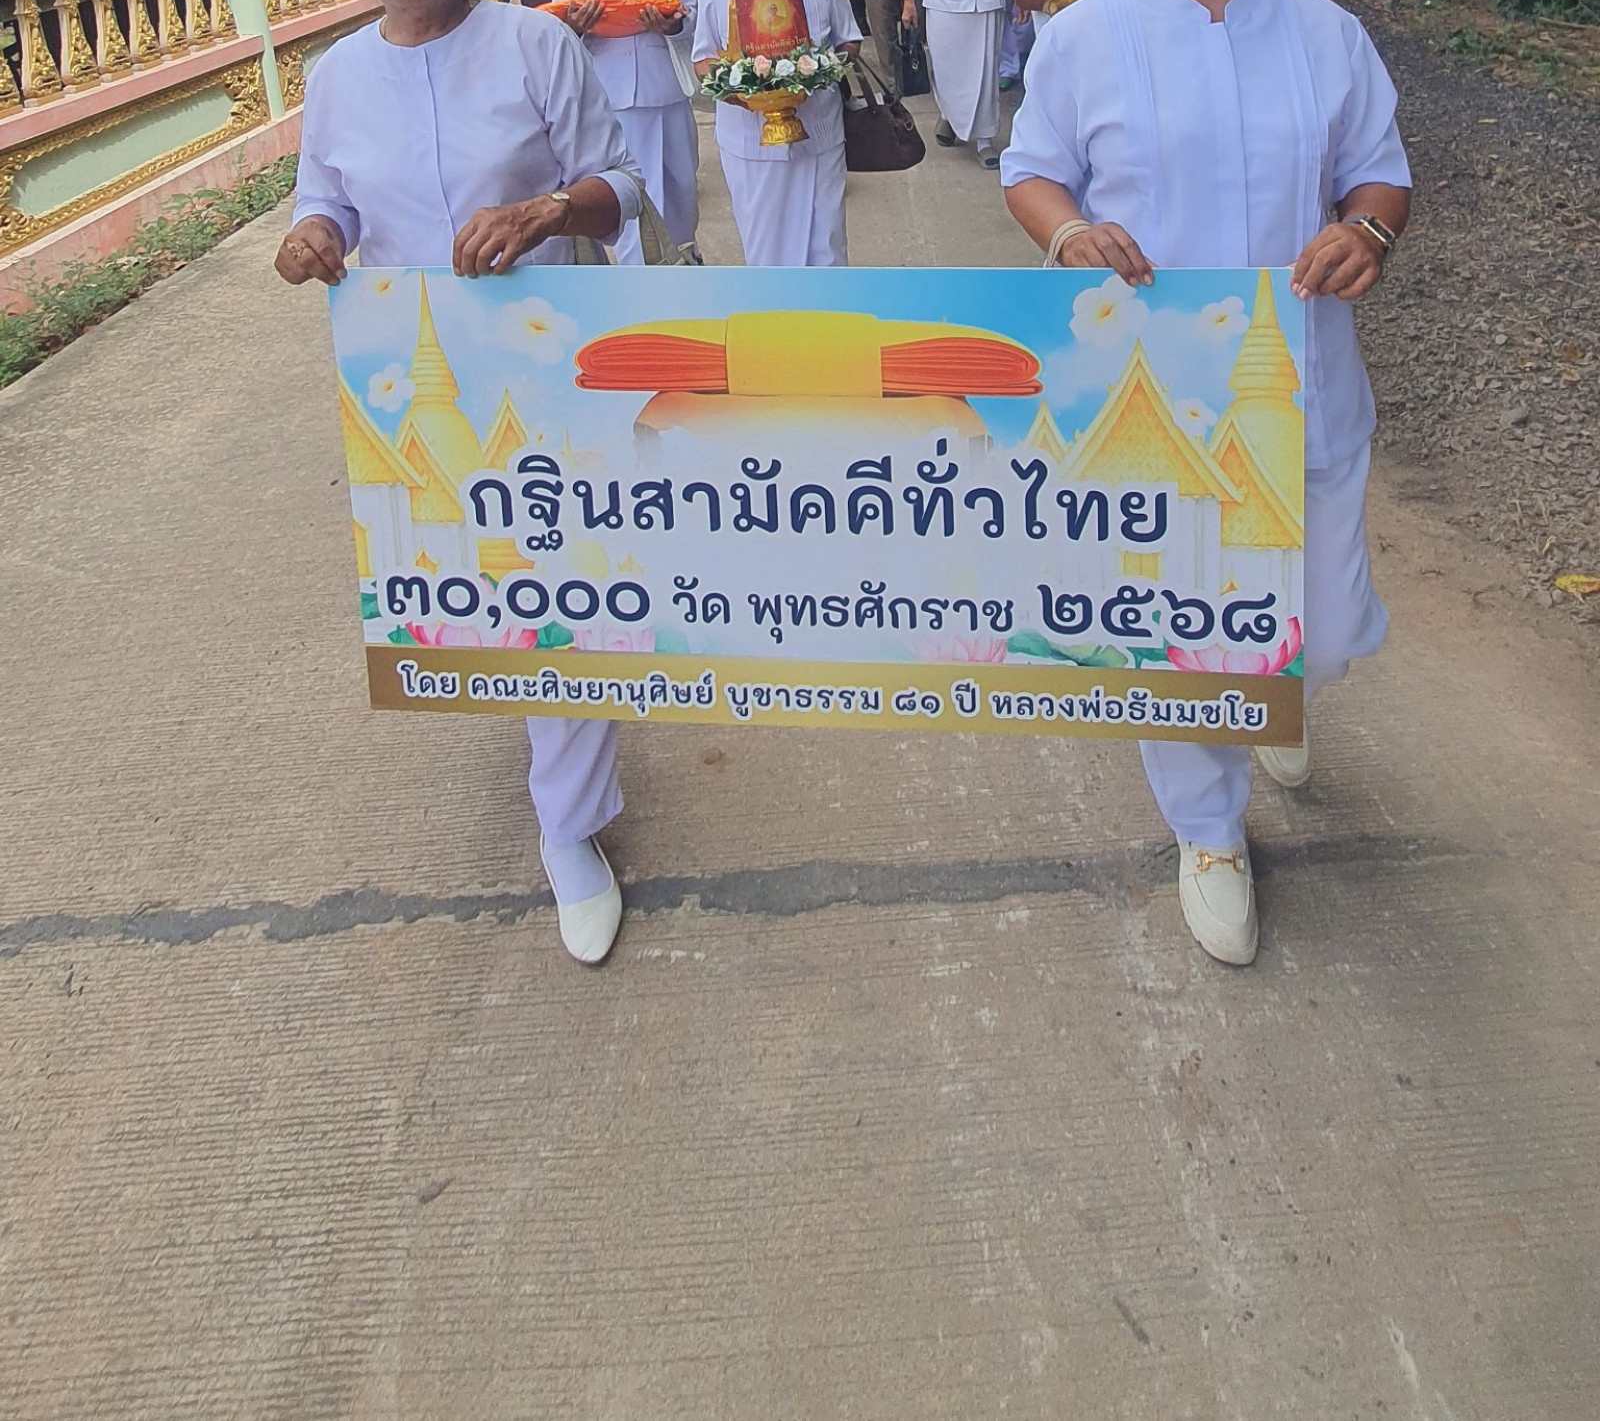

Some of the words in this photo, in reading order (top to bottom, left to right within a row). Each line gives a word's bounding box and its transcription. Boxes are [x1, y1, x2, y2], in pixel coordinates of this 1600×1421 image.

[469, 437, 1168, 552] กฐินสามัคคีทั่วไทย
[385, 574, 651, 629] ๓๐,๐๐๐
[672, 575, 731, 625] วัด
[747, 580, 1014, 645] พุทธศักราช
[1036, 584, 1277, 644] ๒๕๖๘
[400, 662, 458, 696] โดย
[471, 670, 713, 714] คณะศิษยานุศิษย์
[727, 686, 880, 717] บูชาธรรม
[895, 691, 941, 715] ๘๑
[954, 682, 977, 714] ปี
[992, 689, 1263, 727] หลวงพ่อธัมมชโย
